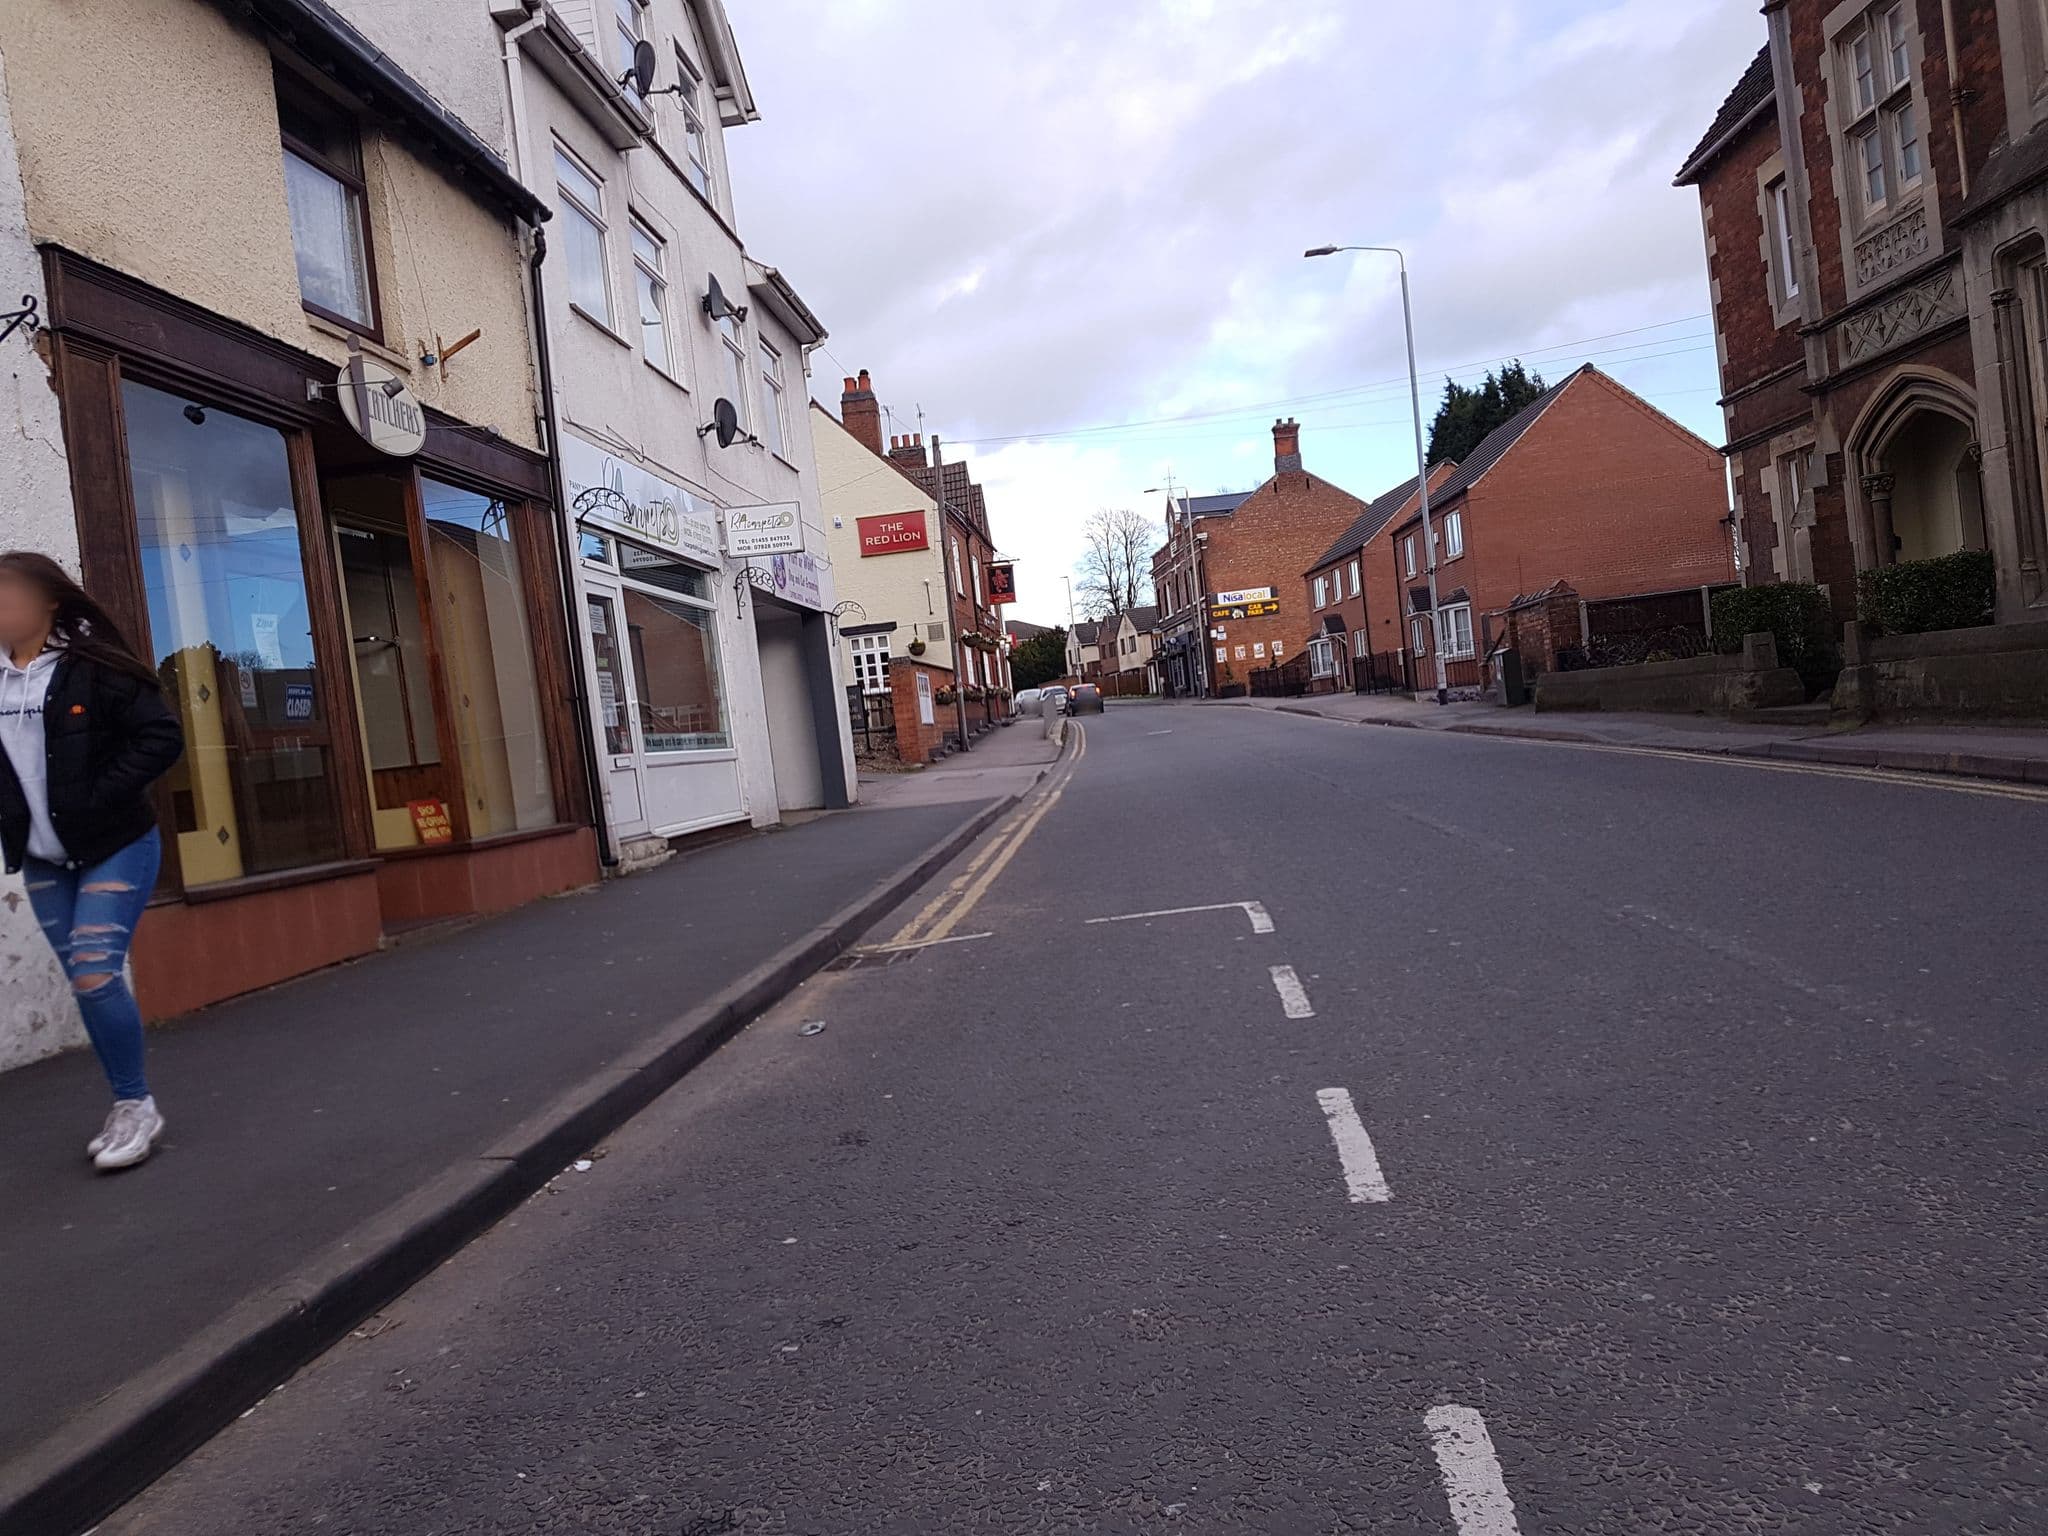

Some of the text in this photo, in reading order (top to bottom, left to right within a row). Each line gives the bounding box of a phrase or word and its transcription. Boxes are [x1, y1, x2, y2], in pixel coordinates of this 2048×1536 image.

[880, 522, 904, 532] THE
[865, 531, 920, 546] RED LION
[1247, 608, 1264, 616] PARK
[287, 698, 311, 717] CLOSED
